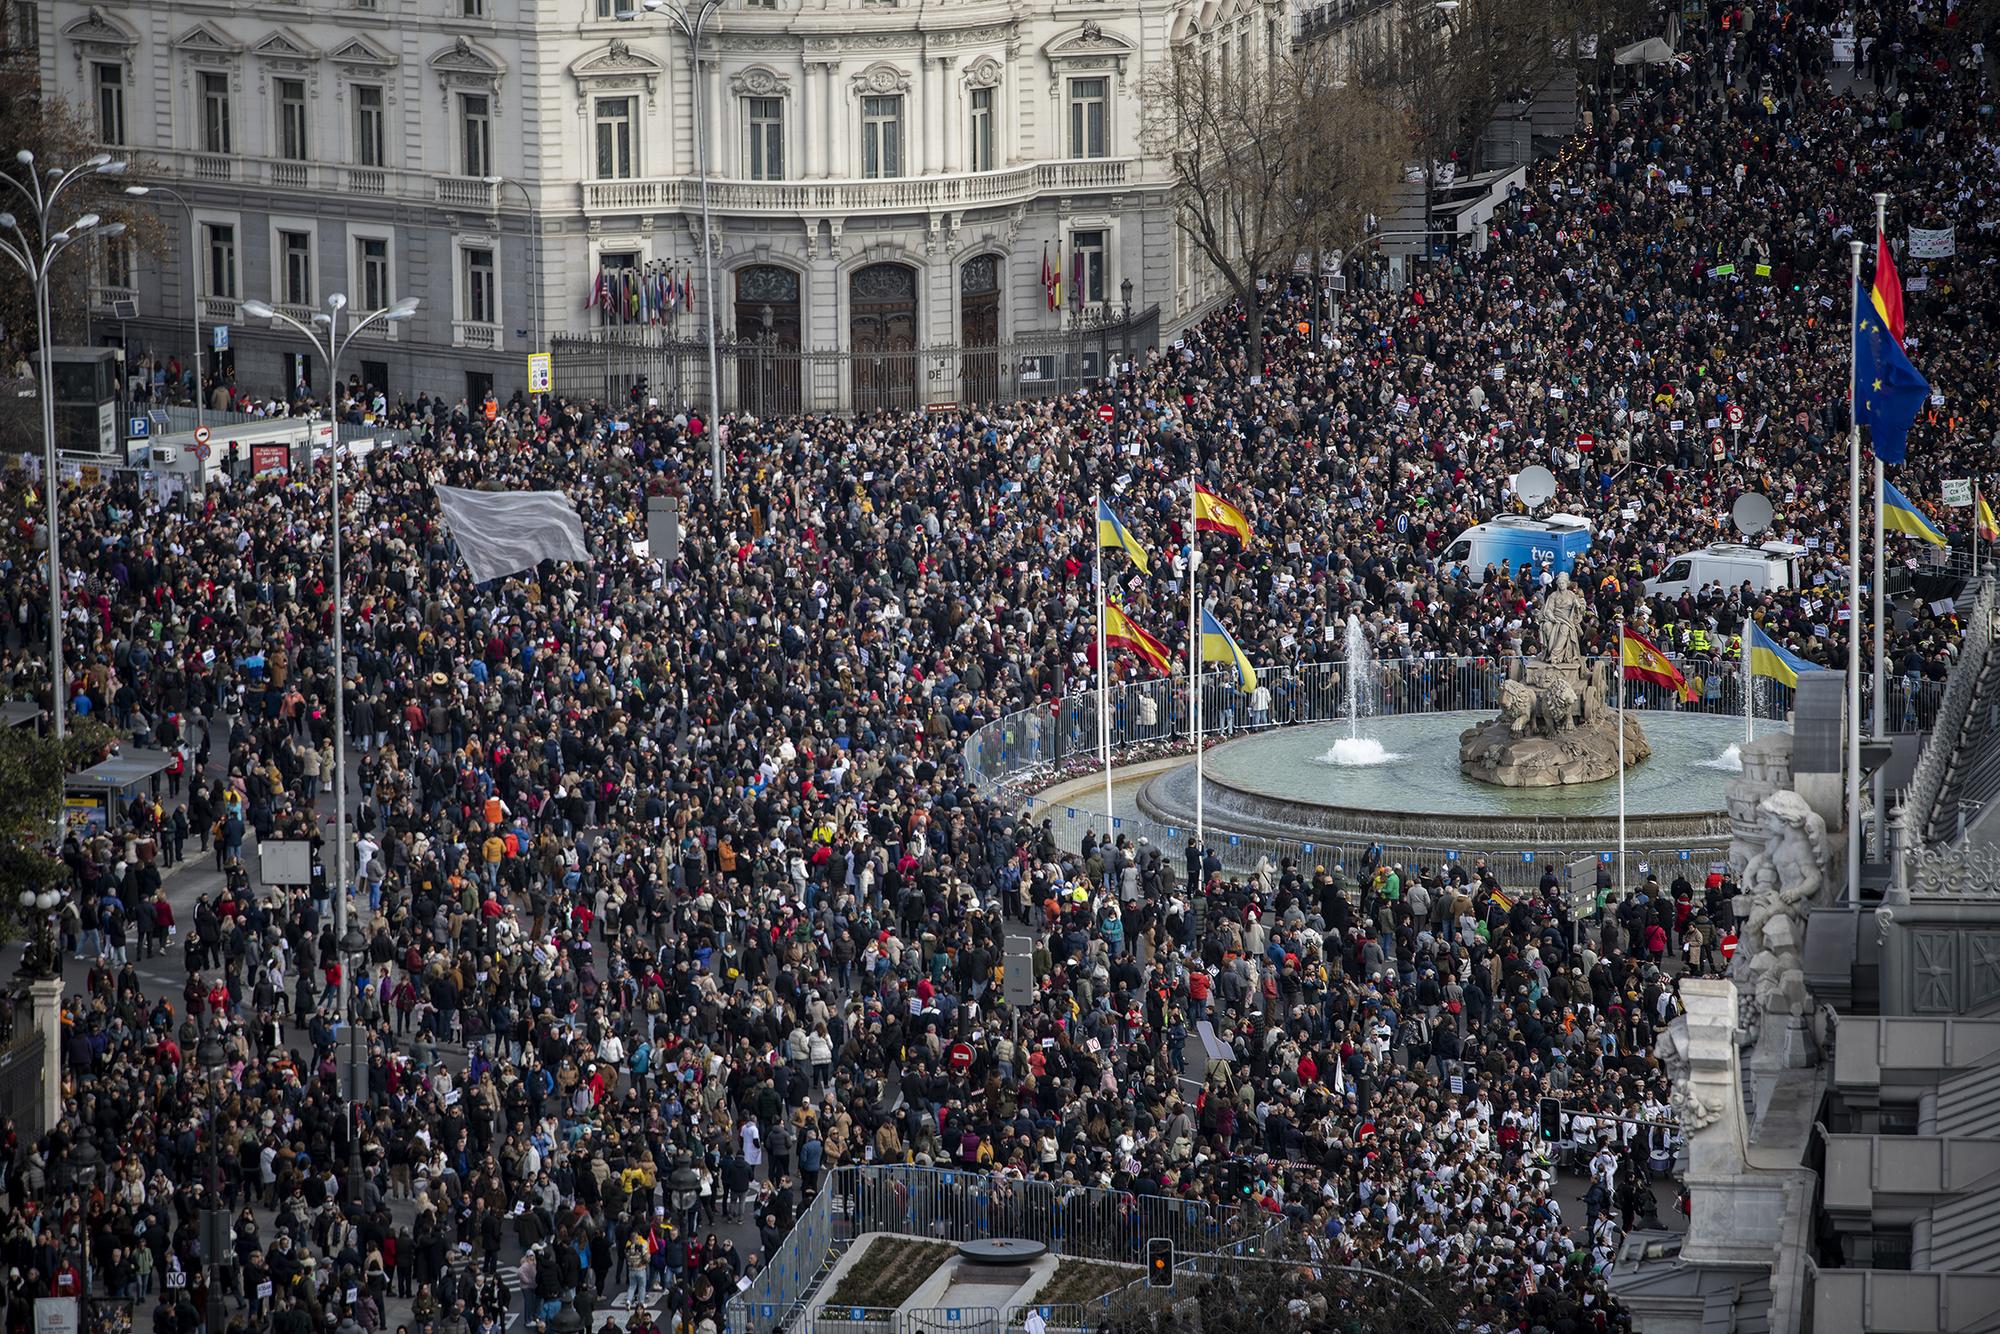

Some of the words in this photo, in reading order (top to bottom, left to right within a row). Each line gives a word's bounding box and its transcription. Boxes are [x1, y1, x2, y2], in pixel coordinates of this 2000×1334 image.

[928, 370, 942, 380] DE
[135, 421, 146, 435] P
[1531, 546, 1555, 561] tve
[1129, 577, 1141, 590] NO
[71, 811, 88, 823] 5G
[1126, 1158, 1142, 1175] NO
[168, 1273, 186, 1287] NO
